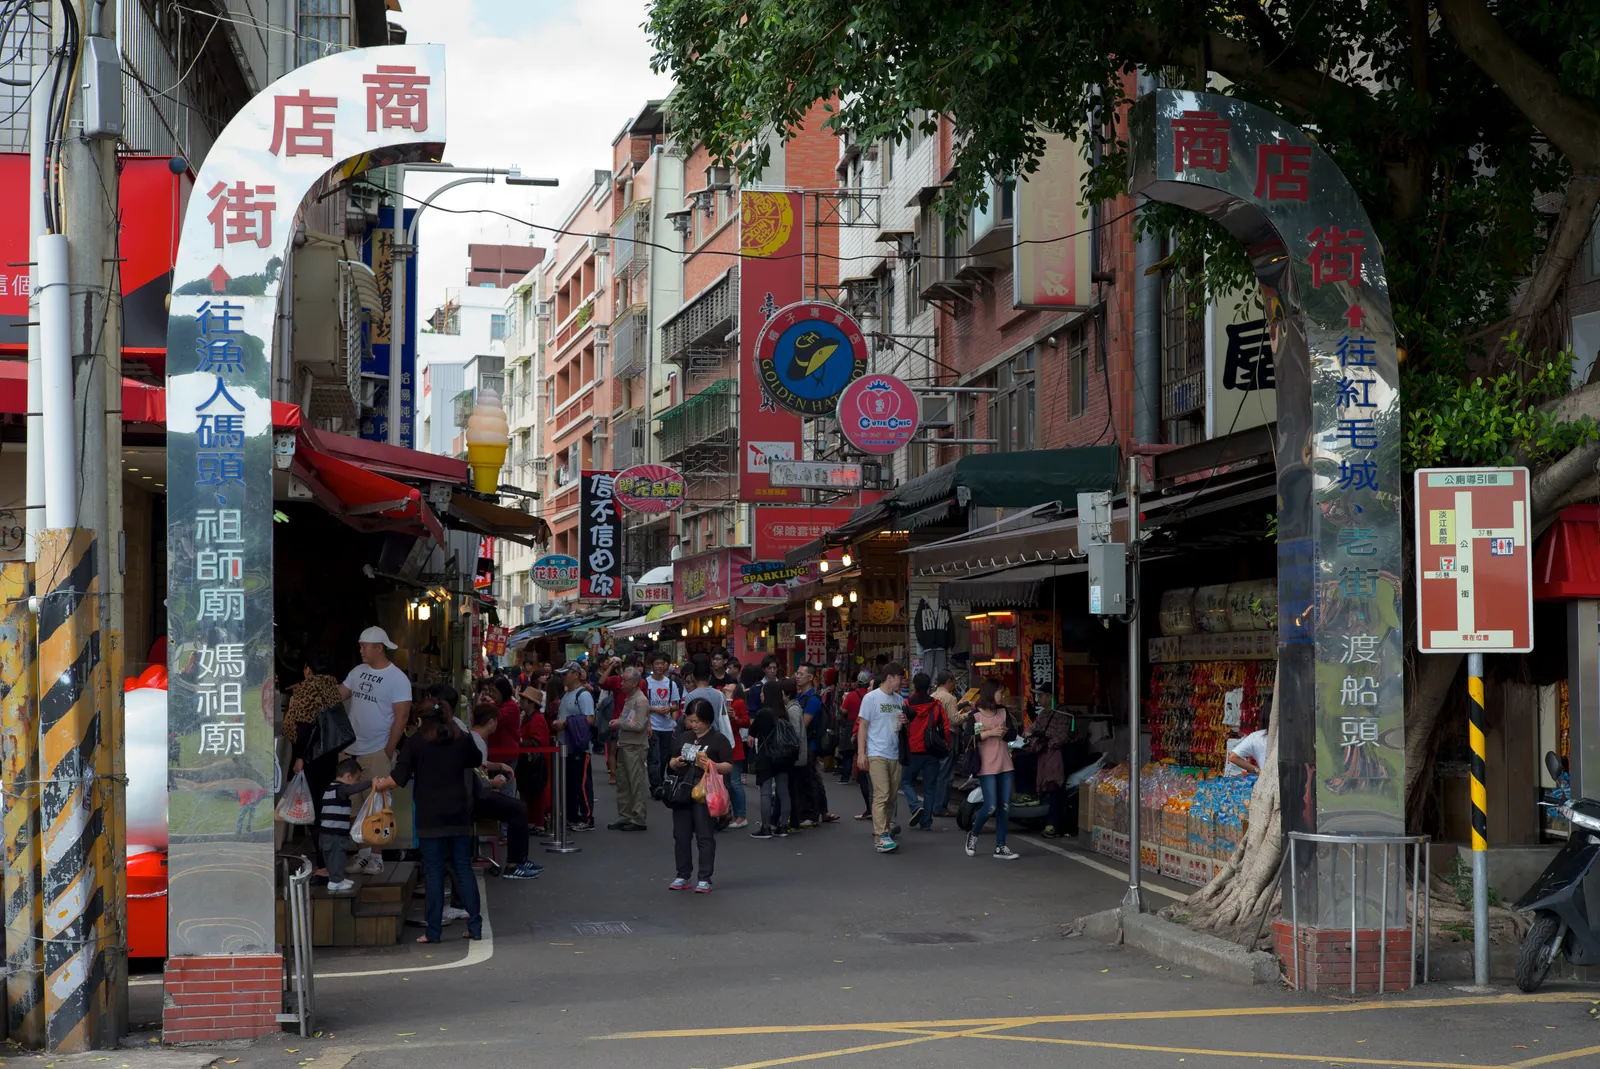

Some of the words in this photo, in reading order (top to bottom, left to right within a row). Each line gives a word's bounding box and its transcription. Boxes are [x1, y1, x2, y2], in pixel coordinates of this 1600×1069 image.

[207, 65, 431, 250] 商店街
[1170, 110, 1365, 289] 商店街
[761, 358, 807, 410] GOLDEN
[812, 393, 840, 412] HAT
[588, 472, 616, 598] 信不信由你
[741, 562, 763, 574] IT'S
[742, 566, 809, 584] SPARKLING!
[1460, 539, 1470, 598] 公明街
[807, 612, 827, 664] 甘蔗汁
[352, 690, 378, 704] FOOTBALL
[360, 671, 384, 684] FITCH
